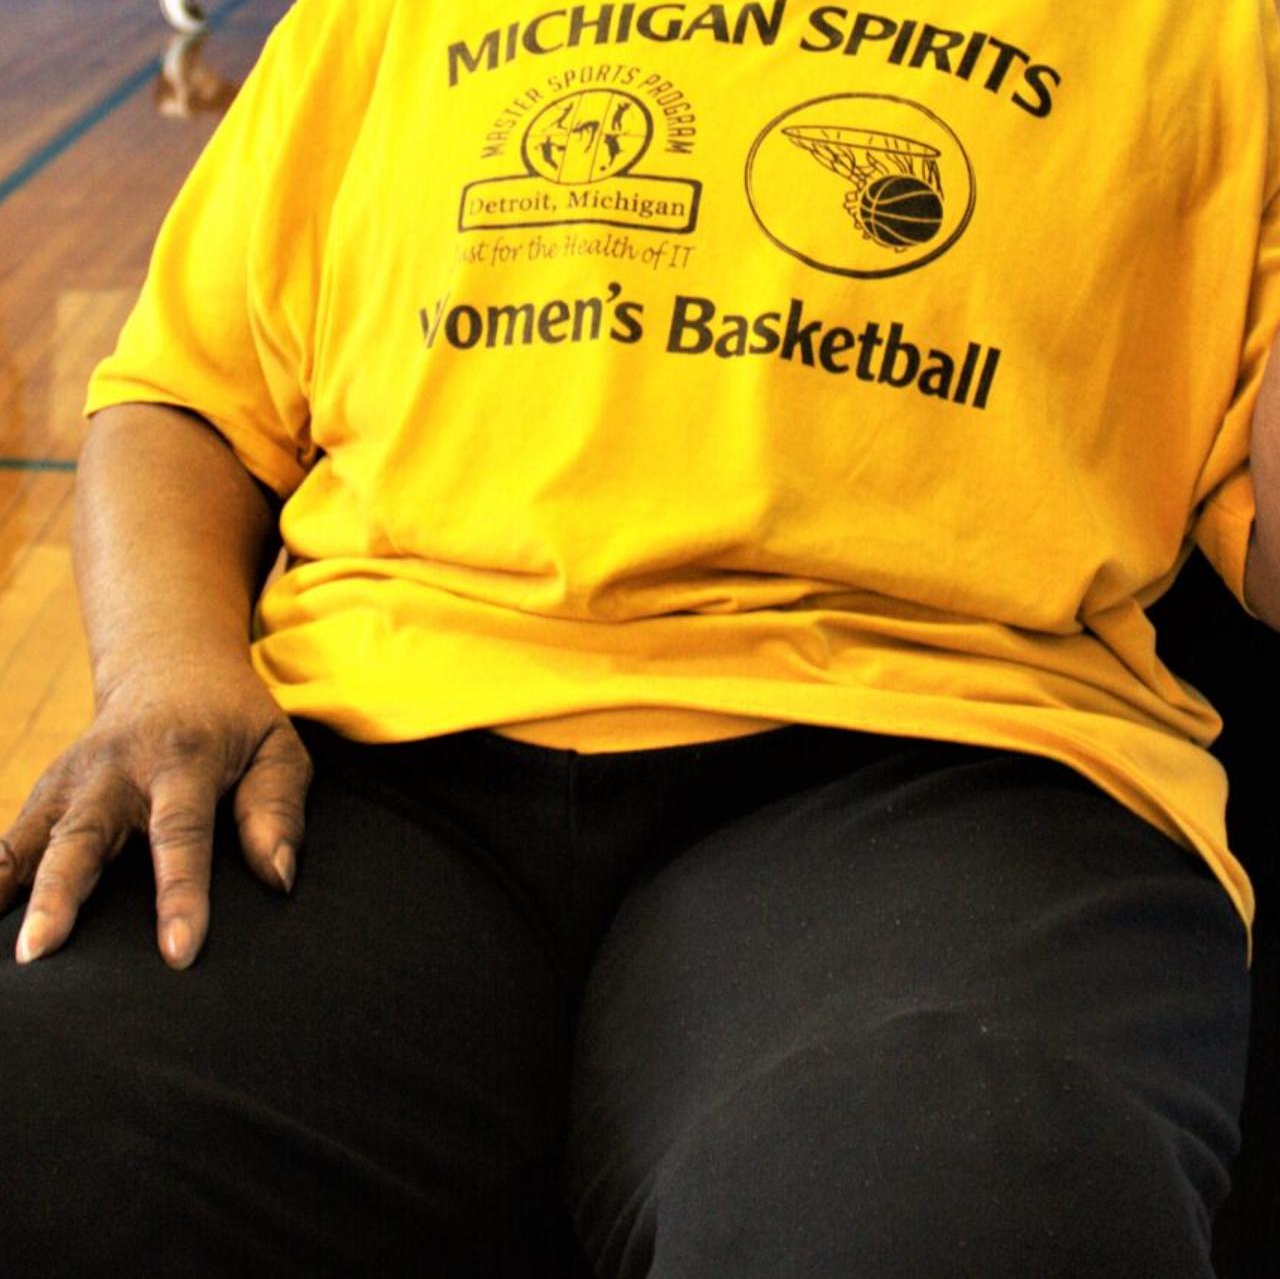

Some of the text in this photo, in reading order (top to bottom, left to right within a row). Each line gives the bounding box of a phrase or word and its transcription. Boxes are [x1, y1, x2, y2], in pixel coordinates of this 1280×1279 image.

[800, 5, 1062, 119] SPIRITS
[480, 64, 697, 160] MASTER SPORTS PROGRAM
[469, 190, 686, 219] Detroit, Michigan
[490, 237, 522, 267] for
[528, 234, 558, 261] the
[564, 232, 636, 262] Health
[641, 239, 669, 271] of
[666, 294, 1003, 411] Basketball
